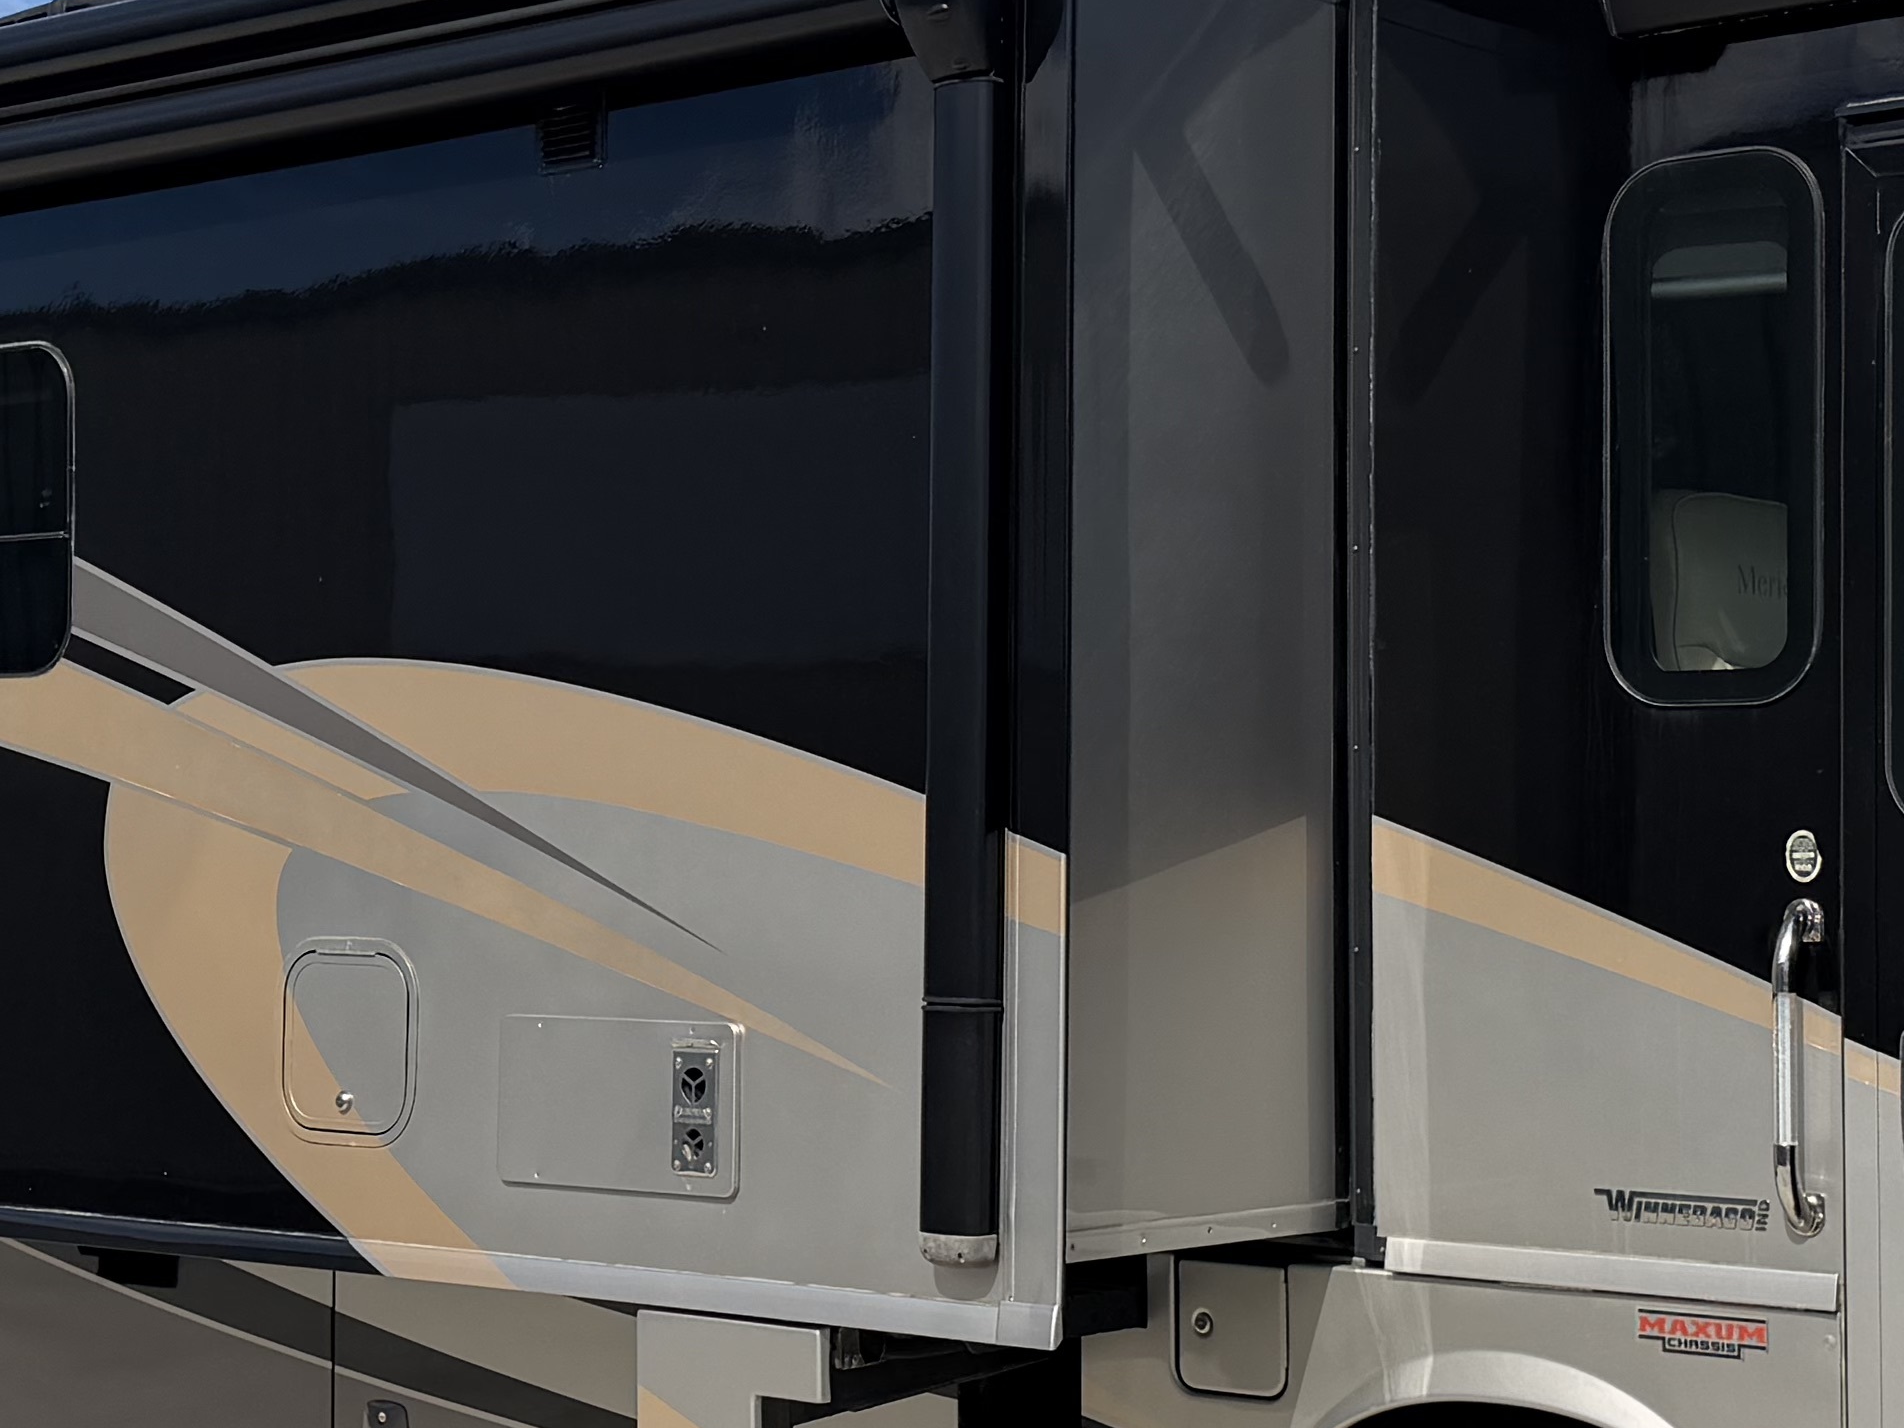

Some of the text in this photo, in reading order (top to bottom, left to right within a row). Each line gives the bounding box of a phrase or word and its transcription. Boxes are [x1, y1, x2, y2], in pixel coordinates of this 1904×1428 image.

[1594, 1187, 1758, 1232] WINNEBAGO
[1638, 1314, 1767, 1344] MAXUM
[1666, 1337, 1737, 1354] CHASSIS
